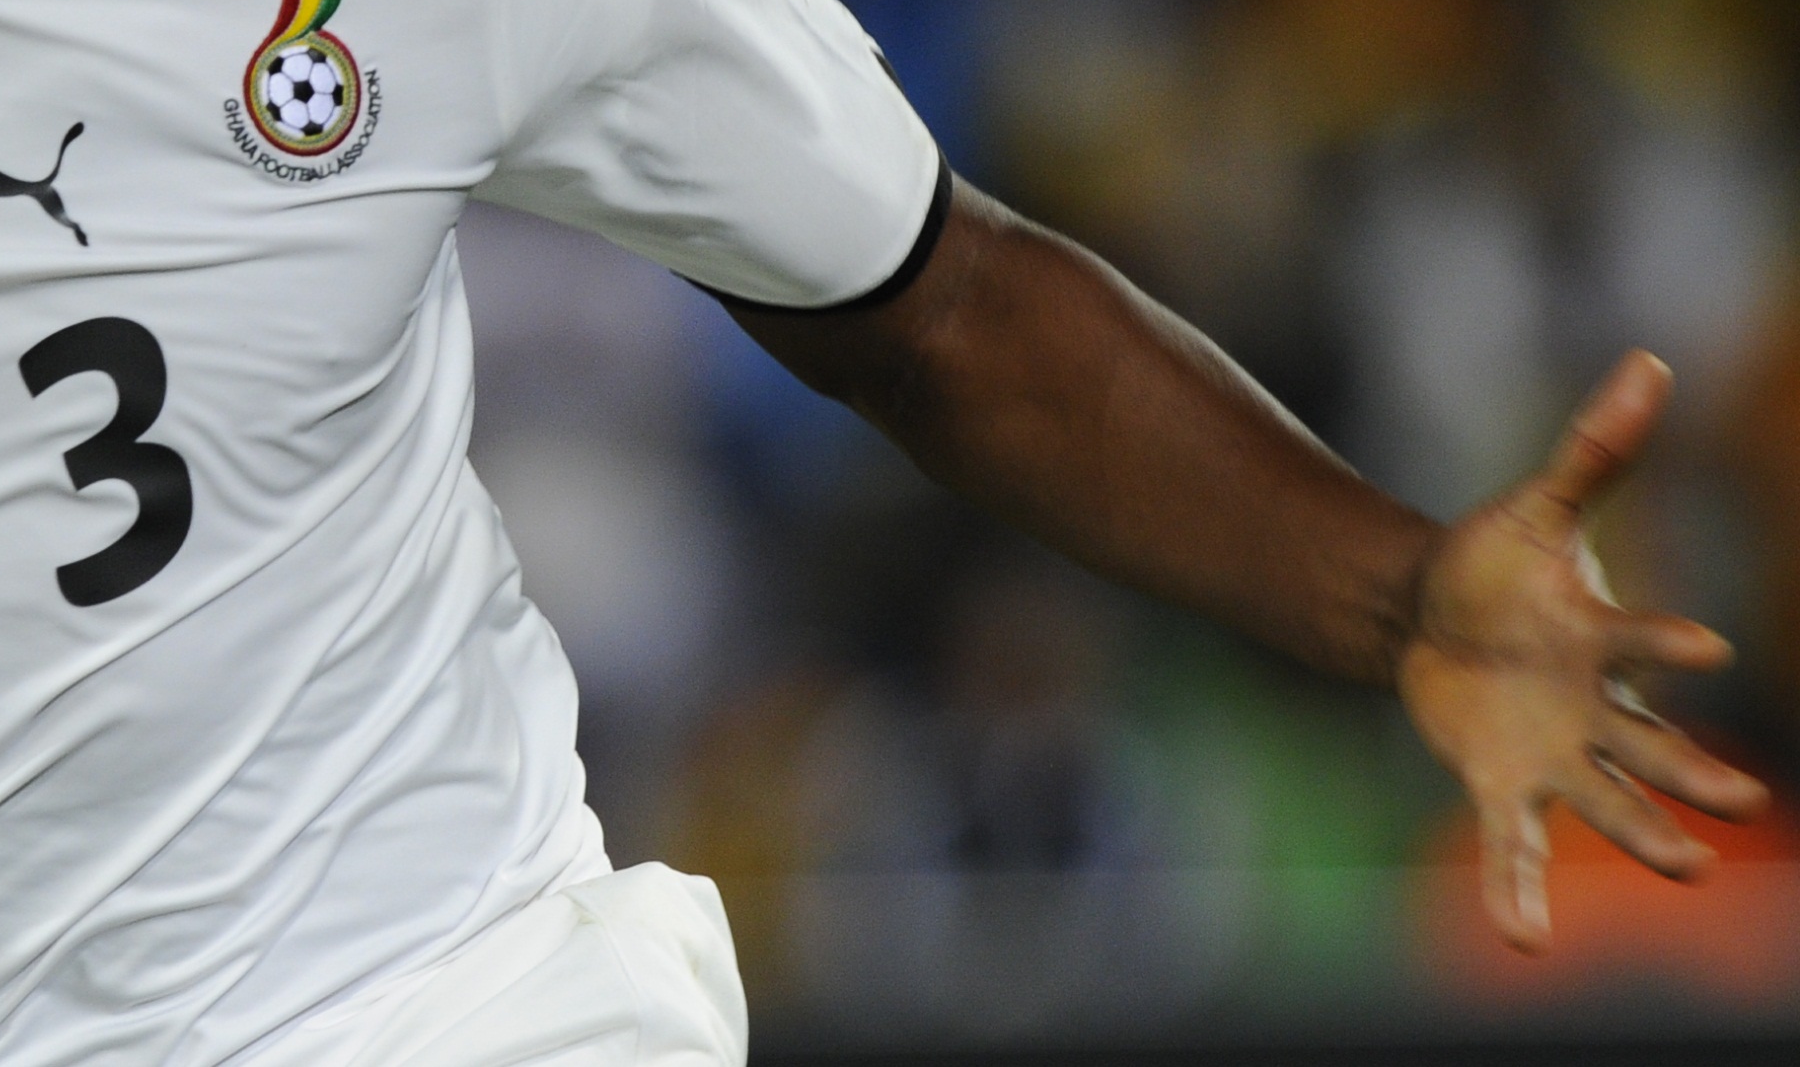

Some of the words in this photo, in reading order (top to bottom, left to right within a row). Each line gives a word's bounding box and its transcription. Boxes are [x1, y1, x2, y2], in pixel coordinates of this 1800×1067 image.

[223, 98, 259, 160] GHANA
[253, 152, 337, 182] FOOTBALL
[336, 67, 382, 174] ASSOCIATION
[18, 316, 193, 608] 3
